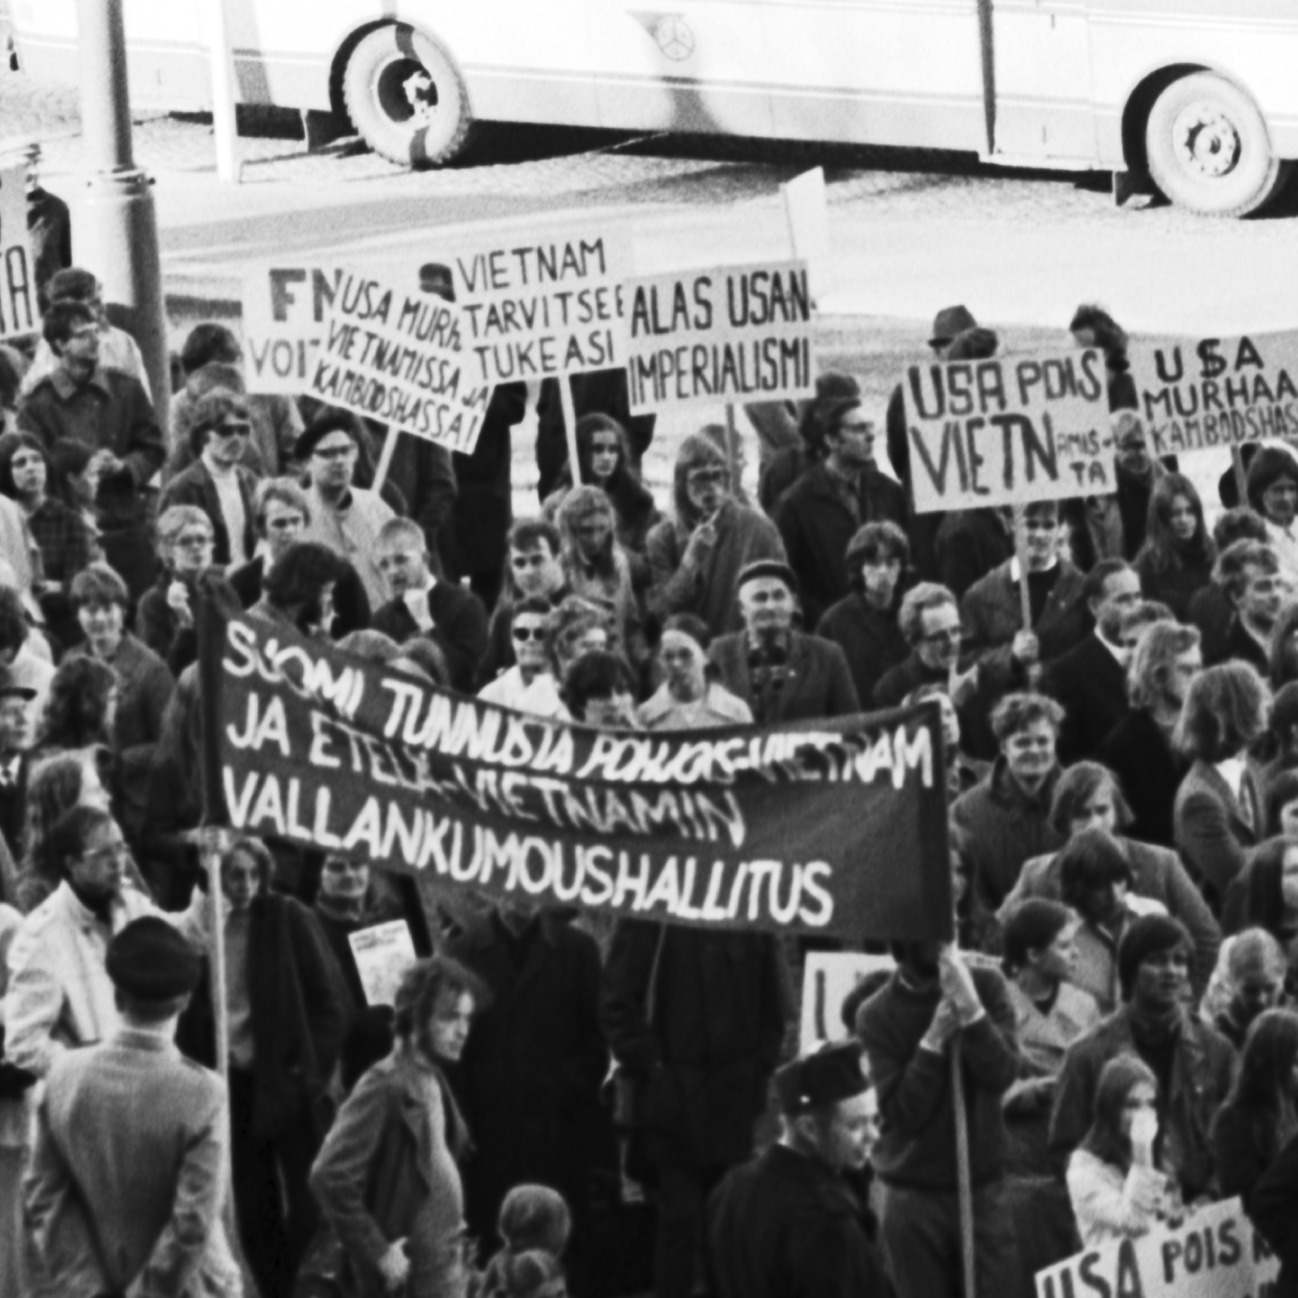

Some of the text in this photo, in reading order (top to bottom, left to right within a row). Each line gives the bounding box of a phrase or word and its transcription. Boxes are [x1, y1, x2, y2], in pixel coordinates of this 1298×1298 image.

[457, 237, 605, 292] VIETNAM
[340, 274, 392, 325] USA
[463, 284, 624, 338] TARVITSEE
[631, 276, 712, 338] ALAS
[328, 318, 460, 400] VIETNAMISSA
[473, 329, 614, 380] TUKEASI
[629, 337, 809, 406] IMPERIALISMI
[908, 349, 1101, 420] USA POIS
[226, 692, 290, 756] JA
[222, 764, 834, 927] VALLANKUMOUSHALLITUS
[1161, 1218, 1241, 1284] POIS
